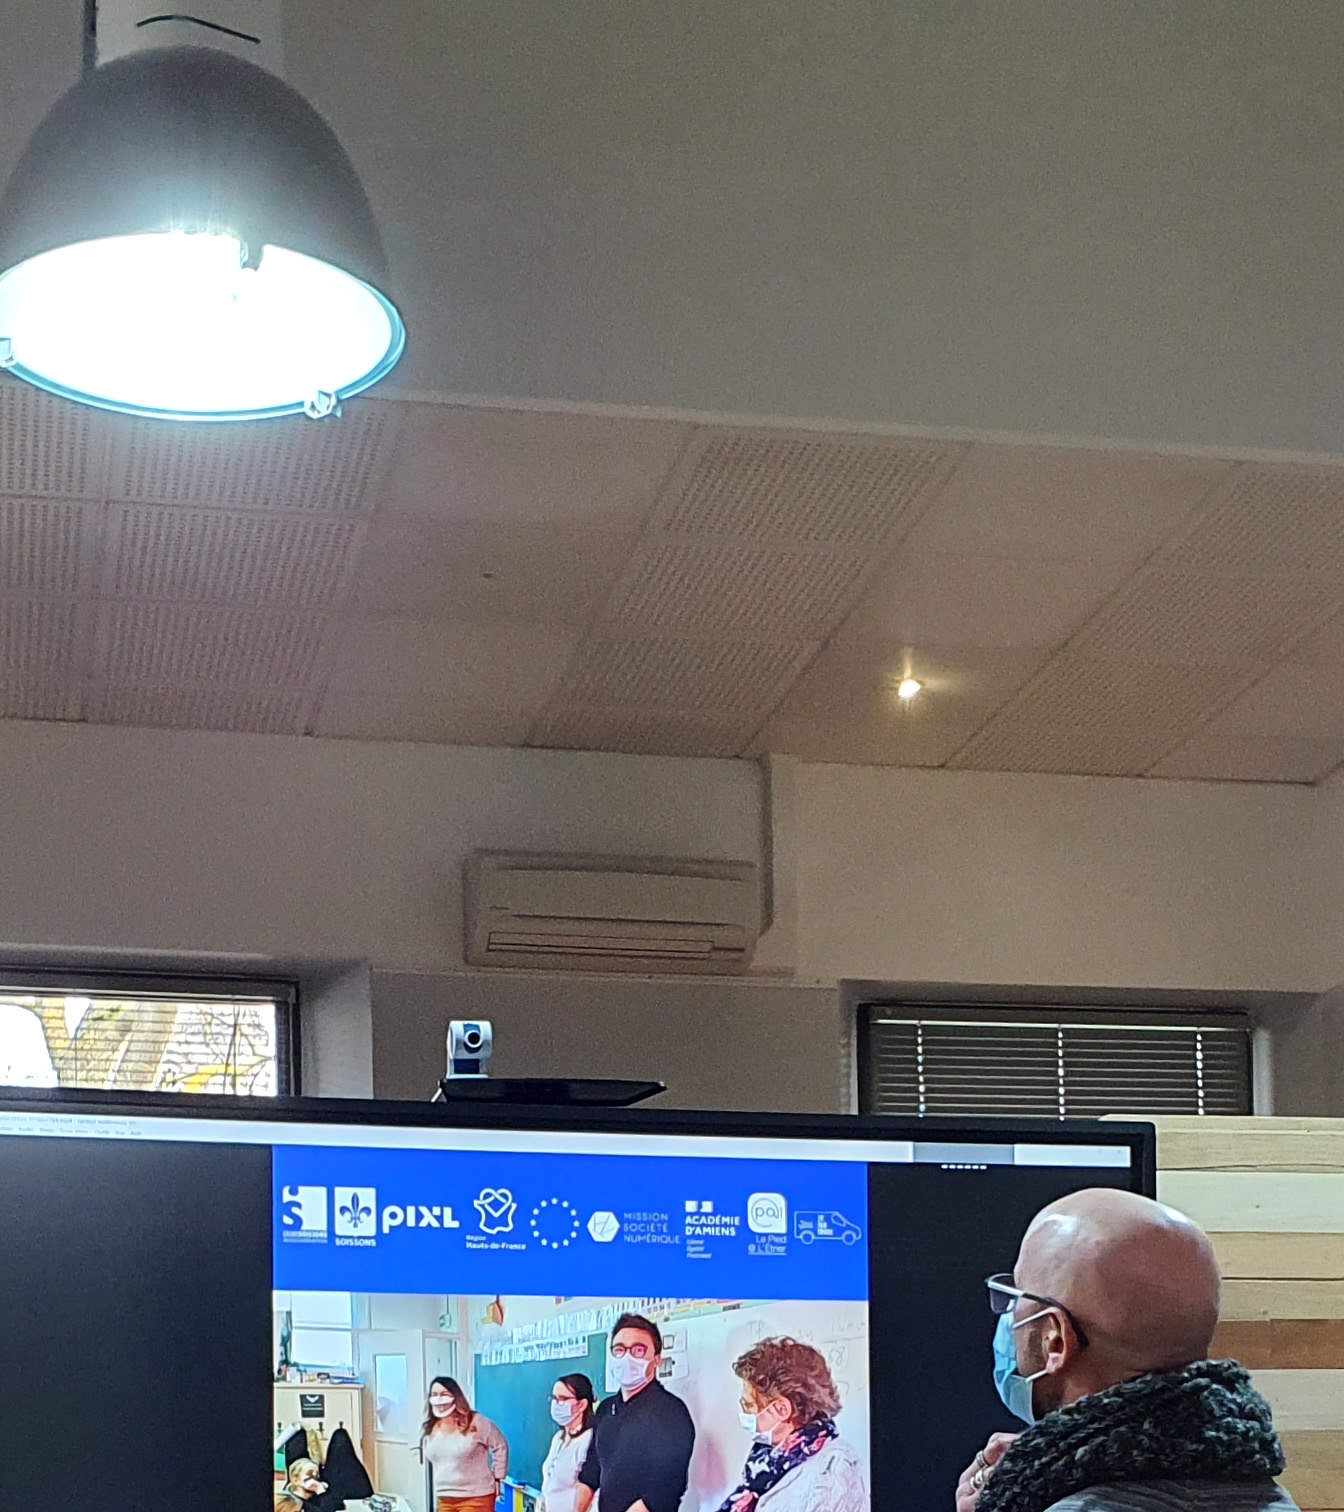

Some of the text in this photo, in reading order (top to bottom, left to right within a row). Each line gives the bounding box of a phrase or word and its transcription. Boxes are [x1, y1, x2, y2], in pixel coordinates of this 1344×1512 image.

[623, 1212, 669, 1221] MISSION
[685, 1214, 741, 1225] ACADÉMIE
[686, 1226, 736, 1236] D'AMIENS
[335, 1238, 376, 1247] SOISSONS
